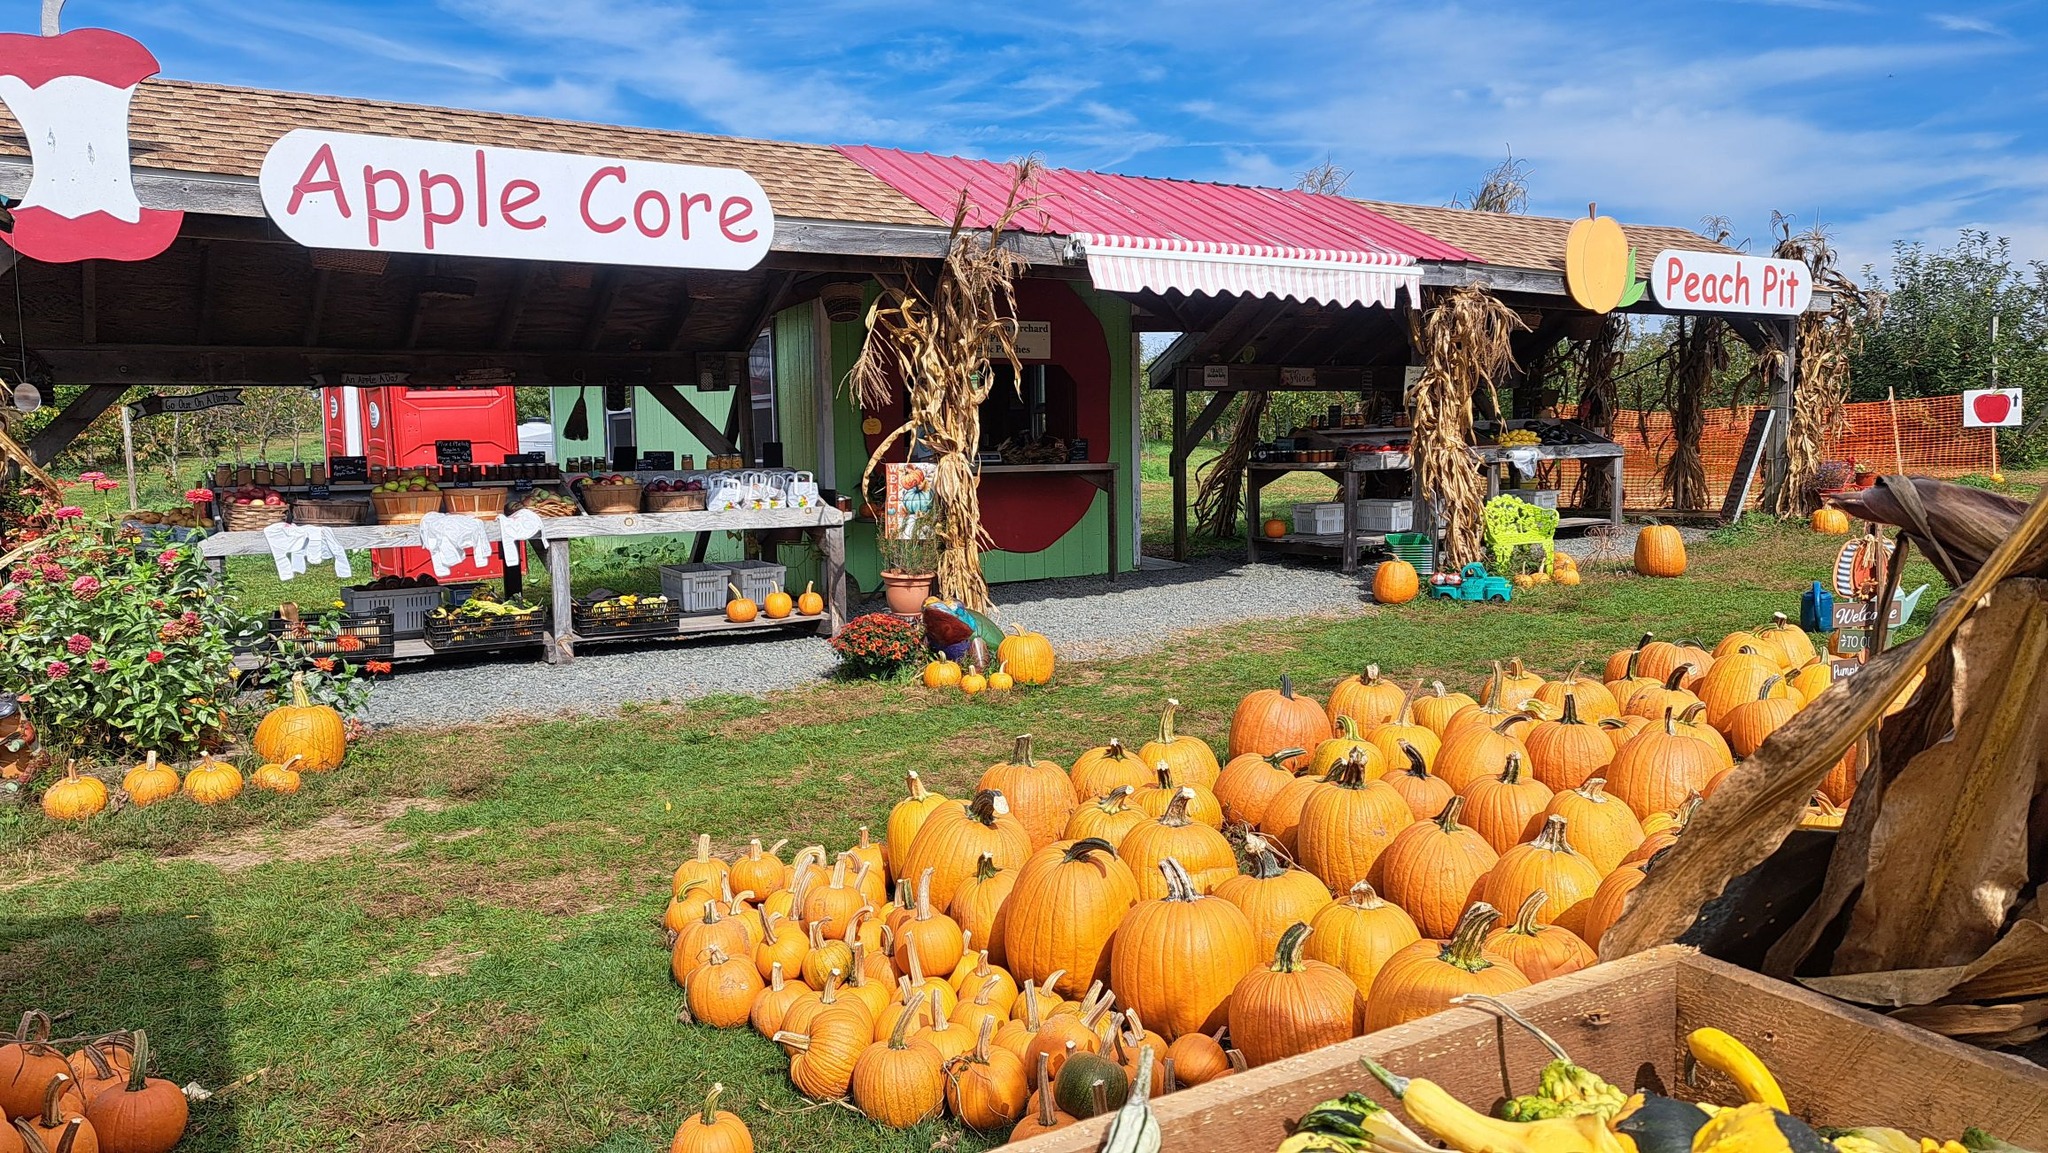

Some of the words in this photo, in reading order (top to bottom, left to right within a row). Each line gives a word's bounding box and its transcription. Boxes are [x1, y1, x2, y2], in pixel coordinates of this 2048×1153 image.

[287, 144, 547, 250] Apple
[580, 166, 760, 245] Core
[1666, 256, 1750, 306] Peach
[1762, 265, 1800, 307] Pit
[165, 400, 175, 410] Go
[1835, 603, 1898, 625] Welcoe
[1846, 635, 1859, 648] TO
